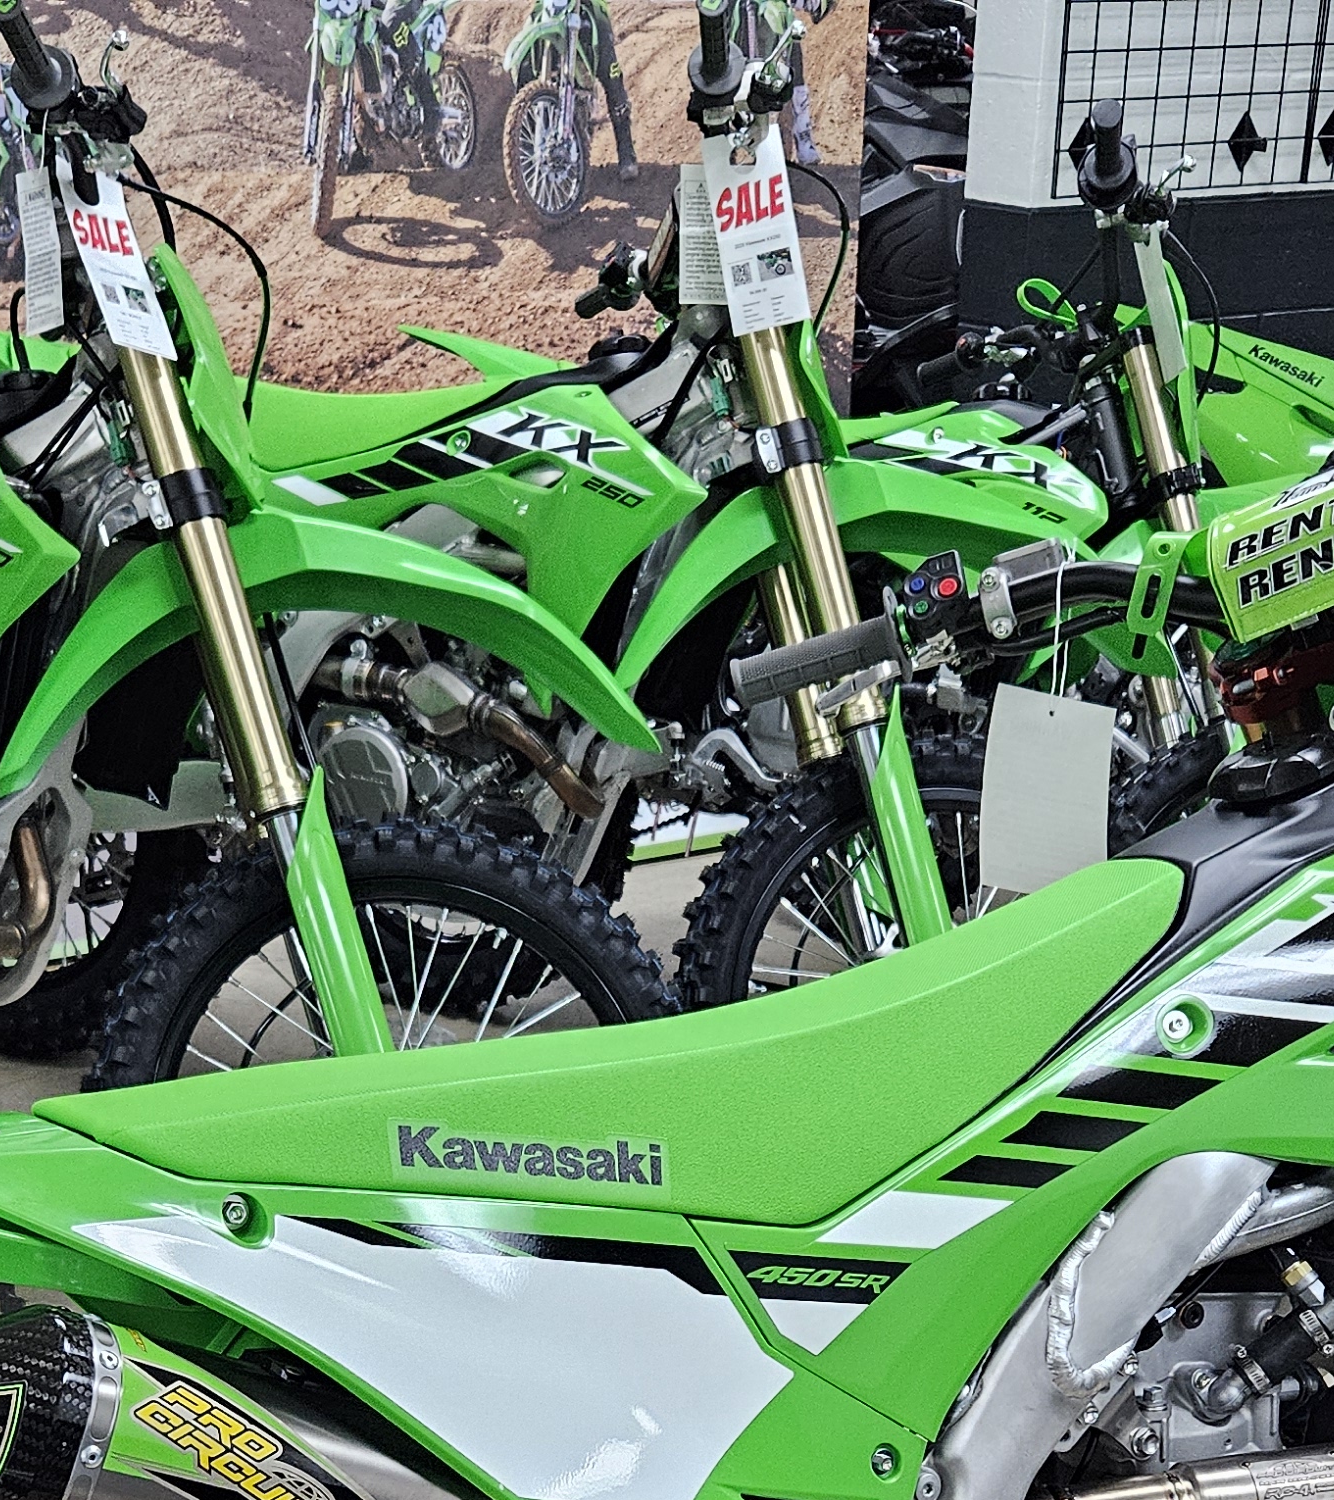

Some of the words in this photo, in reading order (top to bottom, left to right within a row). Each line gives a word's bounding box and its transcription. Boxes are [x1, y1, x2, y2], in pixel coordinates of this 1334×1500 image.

[72, 208, 134, 256] SALE
[716, 173, 785, 233] SALE
[1247, 342, 1325, 389] Kawasaki
[498, 406, 629, 470] KX
[579, 476, 646, 508] 250
[396, 1124, 663, 1187] Kawasaki
[158, 1384, 280, 1462] PRO
